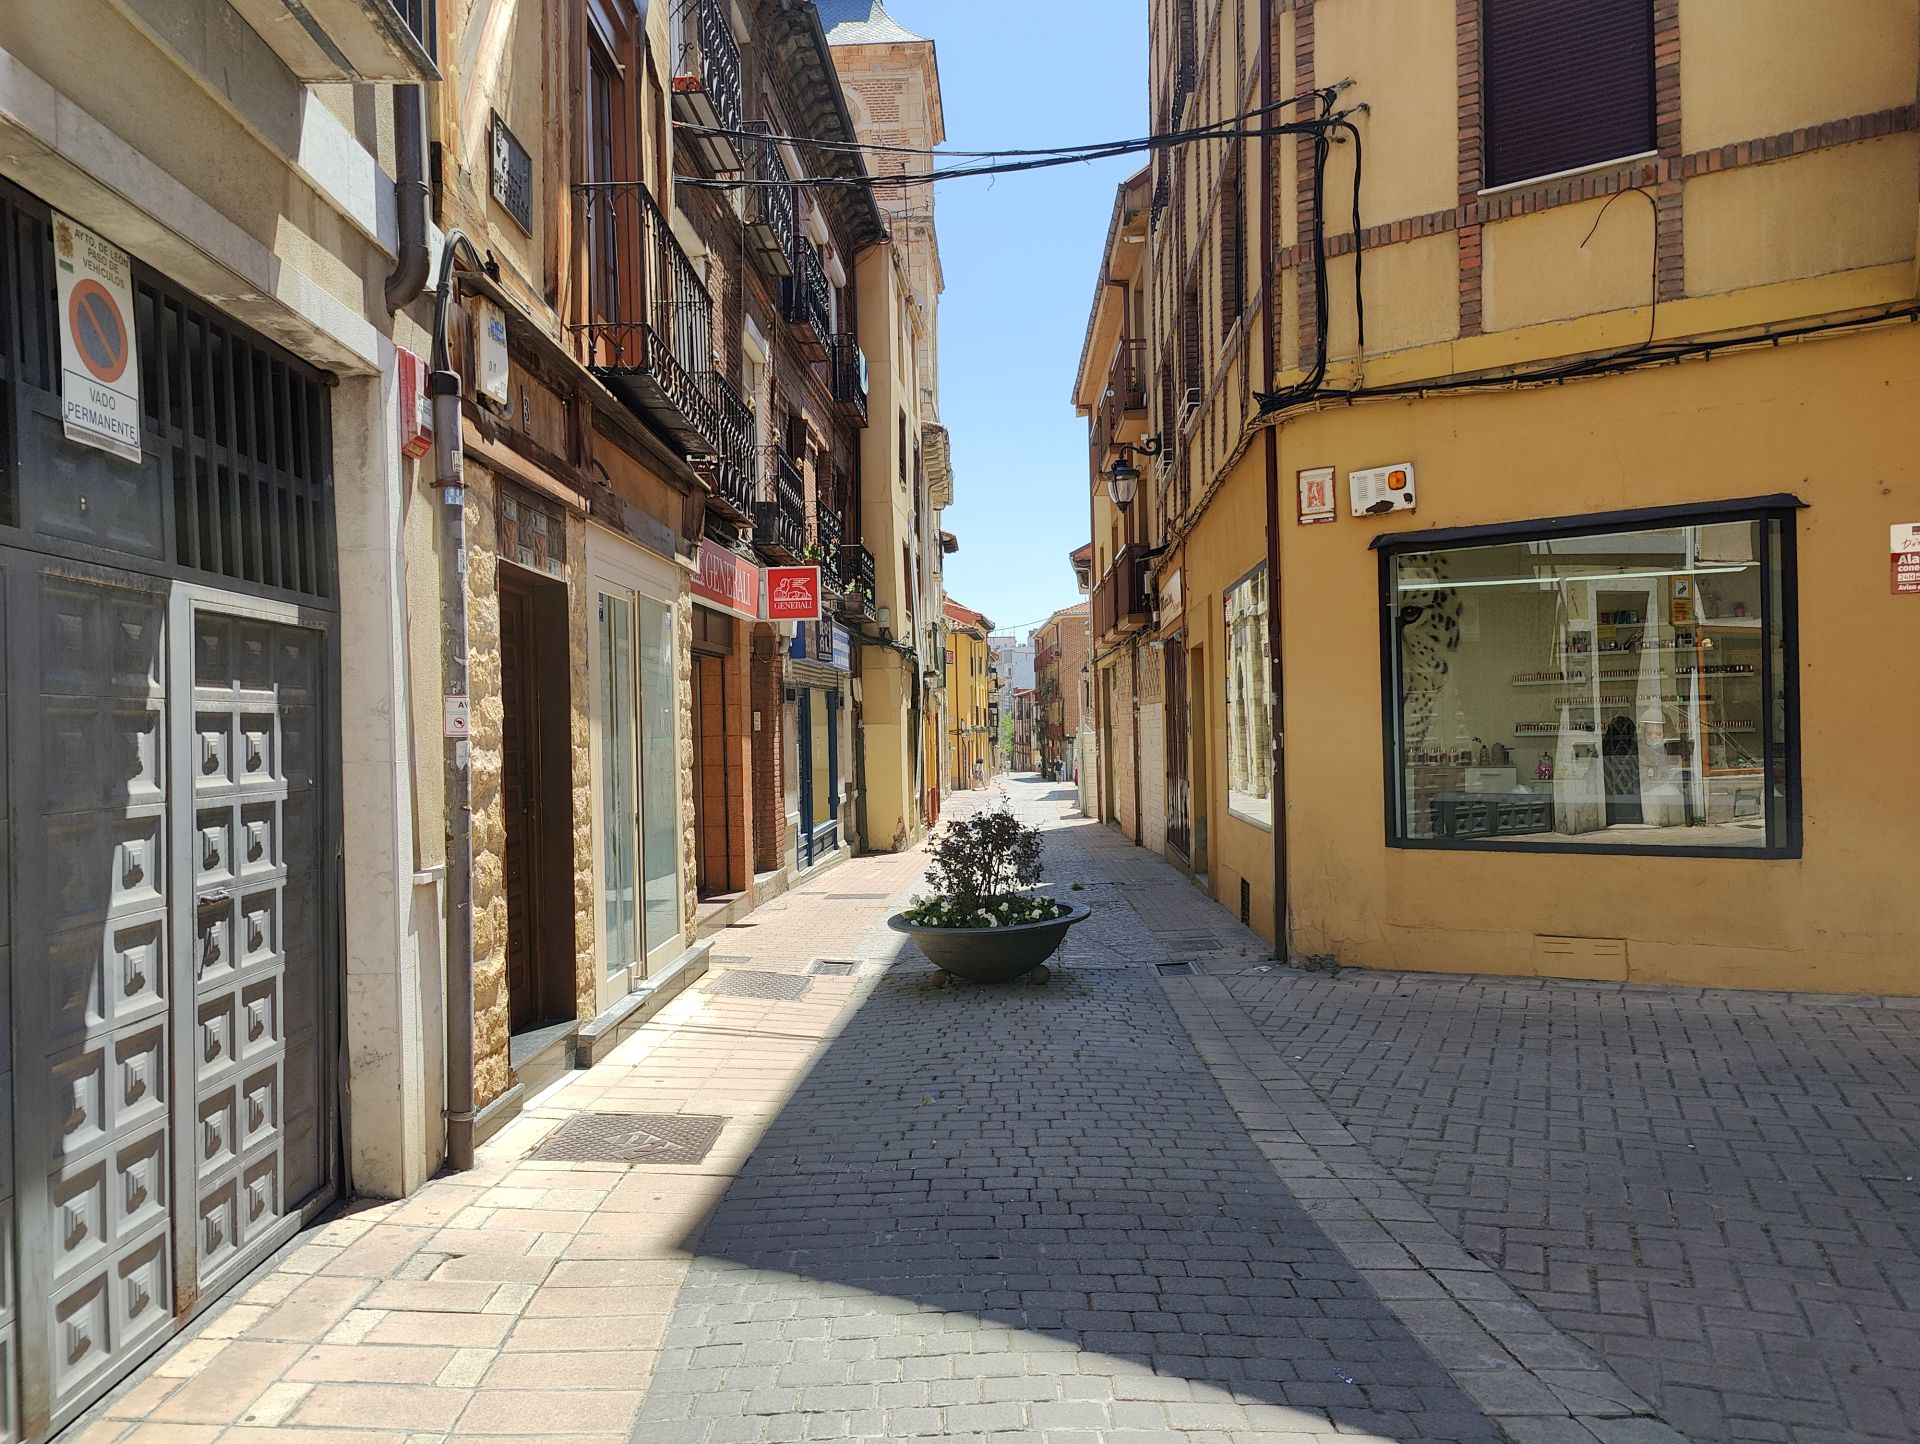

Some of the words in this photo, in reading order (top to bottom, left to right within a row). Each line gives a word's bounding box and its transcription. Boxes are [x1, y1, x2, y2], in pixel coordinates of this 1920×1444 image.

[74, 229, 97, 249] AYTO.
[99, 242, 109, 257] DE
[87, 247, 107, 266] PASO
[109, 260, 119, 274] DE
[89, 387, 116, 411] VADO
[67, 401, 136, 441] PERMANENTE
[705, 551, 751, 607] GENERALI
[774, 600, 812, 610] GENERALI
